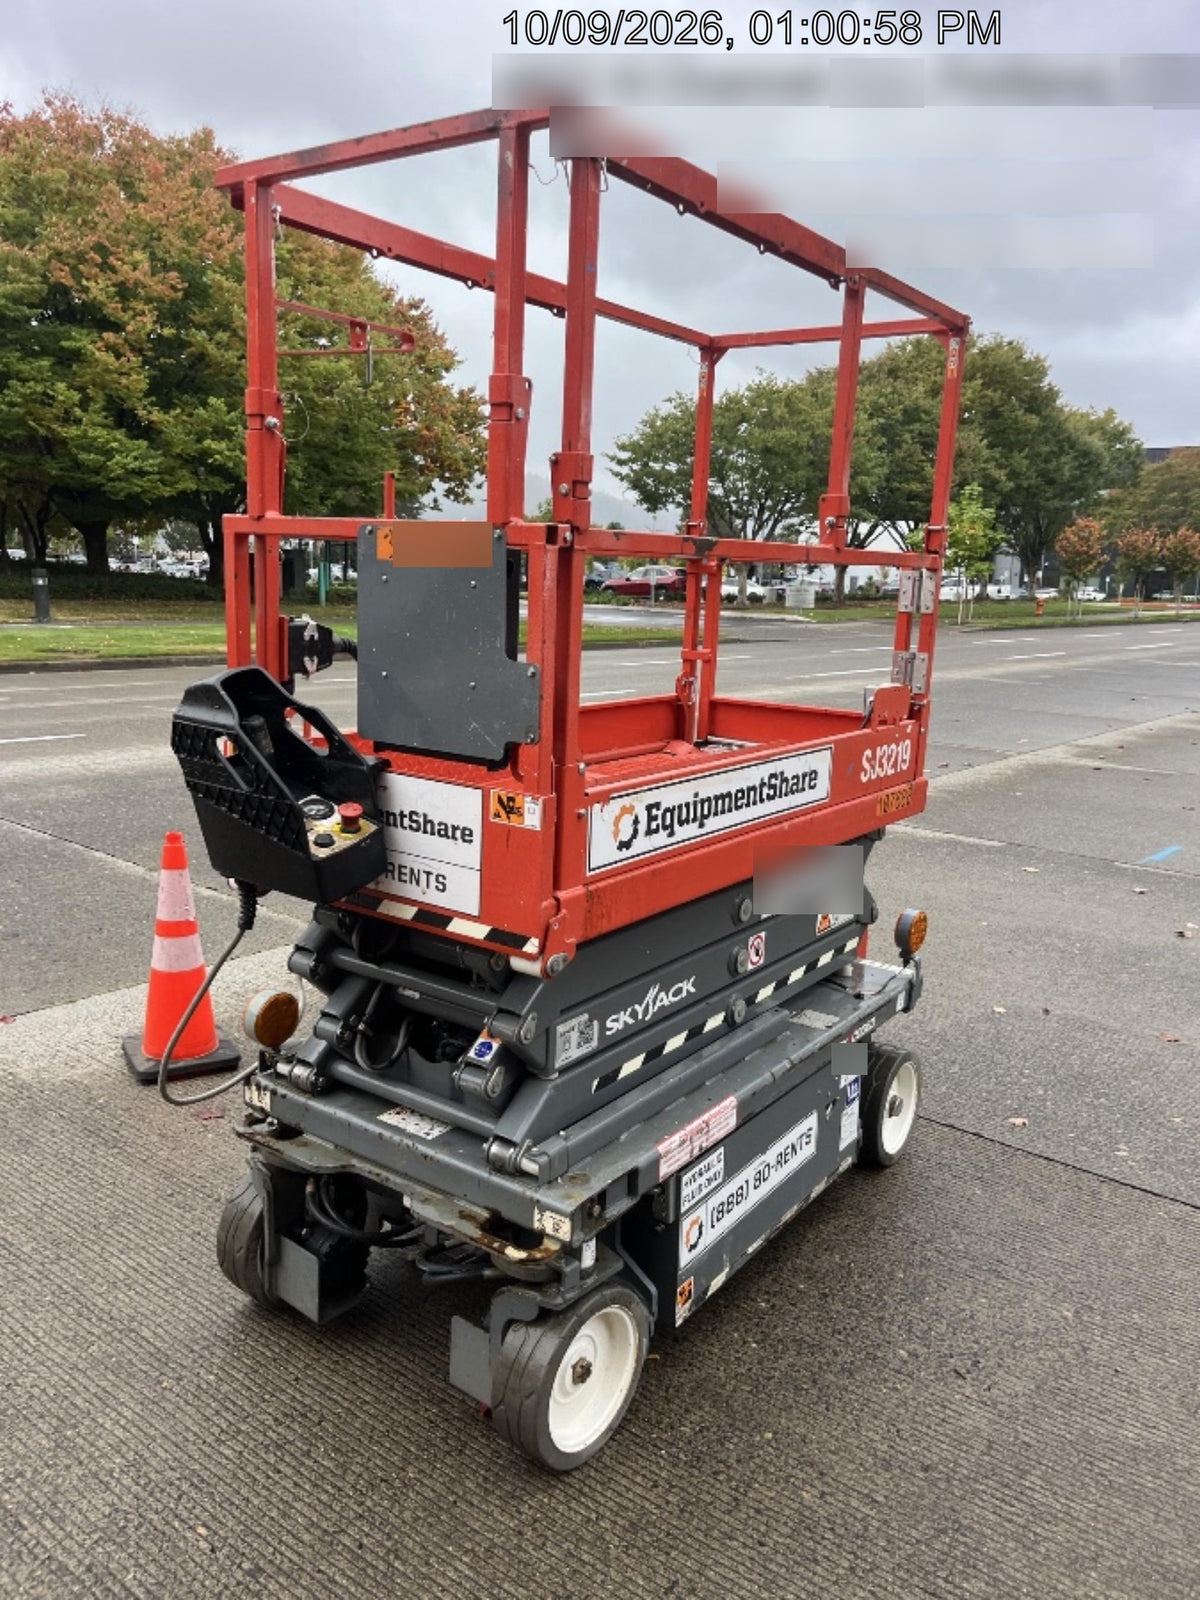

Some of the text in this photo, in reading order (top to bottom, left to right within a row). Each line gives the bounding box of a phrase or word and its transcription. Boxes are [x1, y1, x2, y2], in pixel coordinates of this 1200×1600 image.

[860, 738, 912, 783] SJ3219
[644, 767, 819, 838] EquipmentShare
[384, 860, 447, 893] RENTS
[605, 975, 697, 1036] SKYJACK
[710, 1179, 750, 1229] (888)
